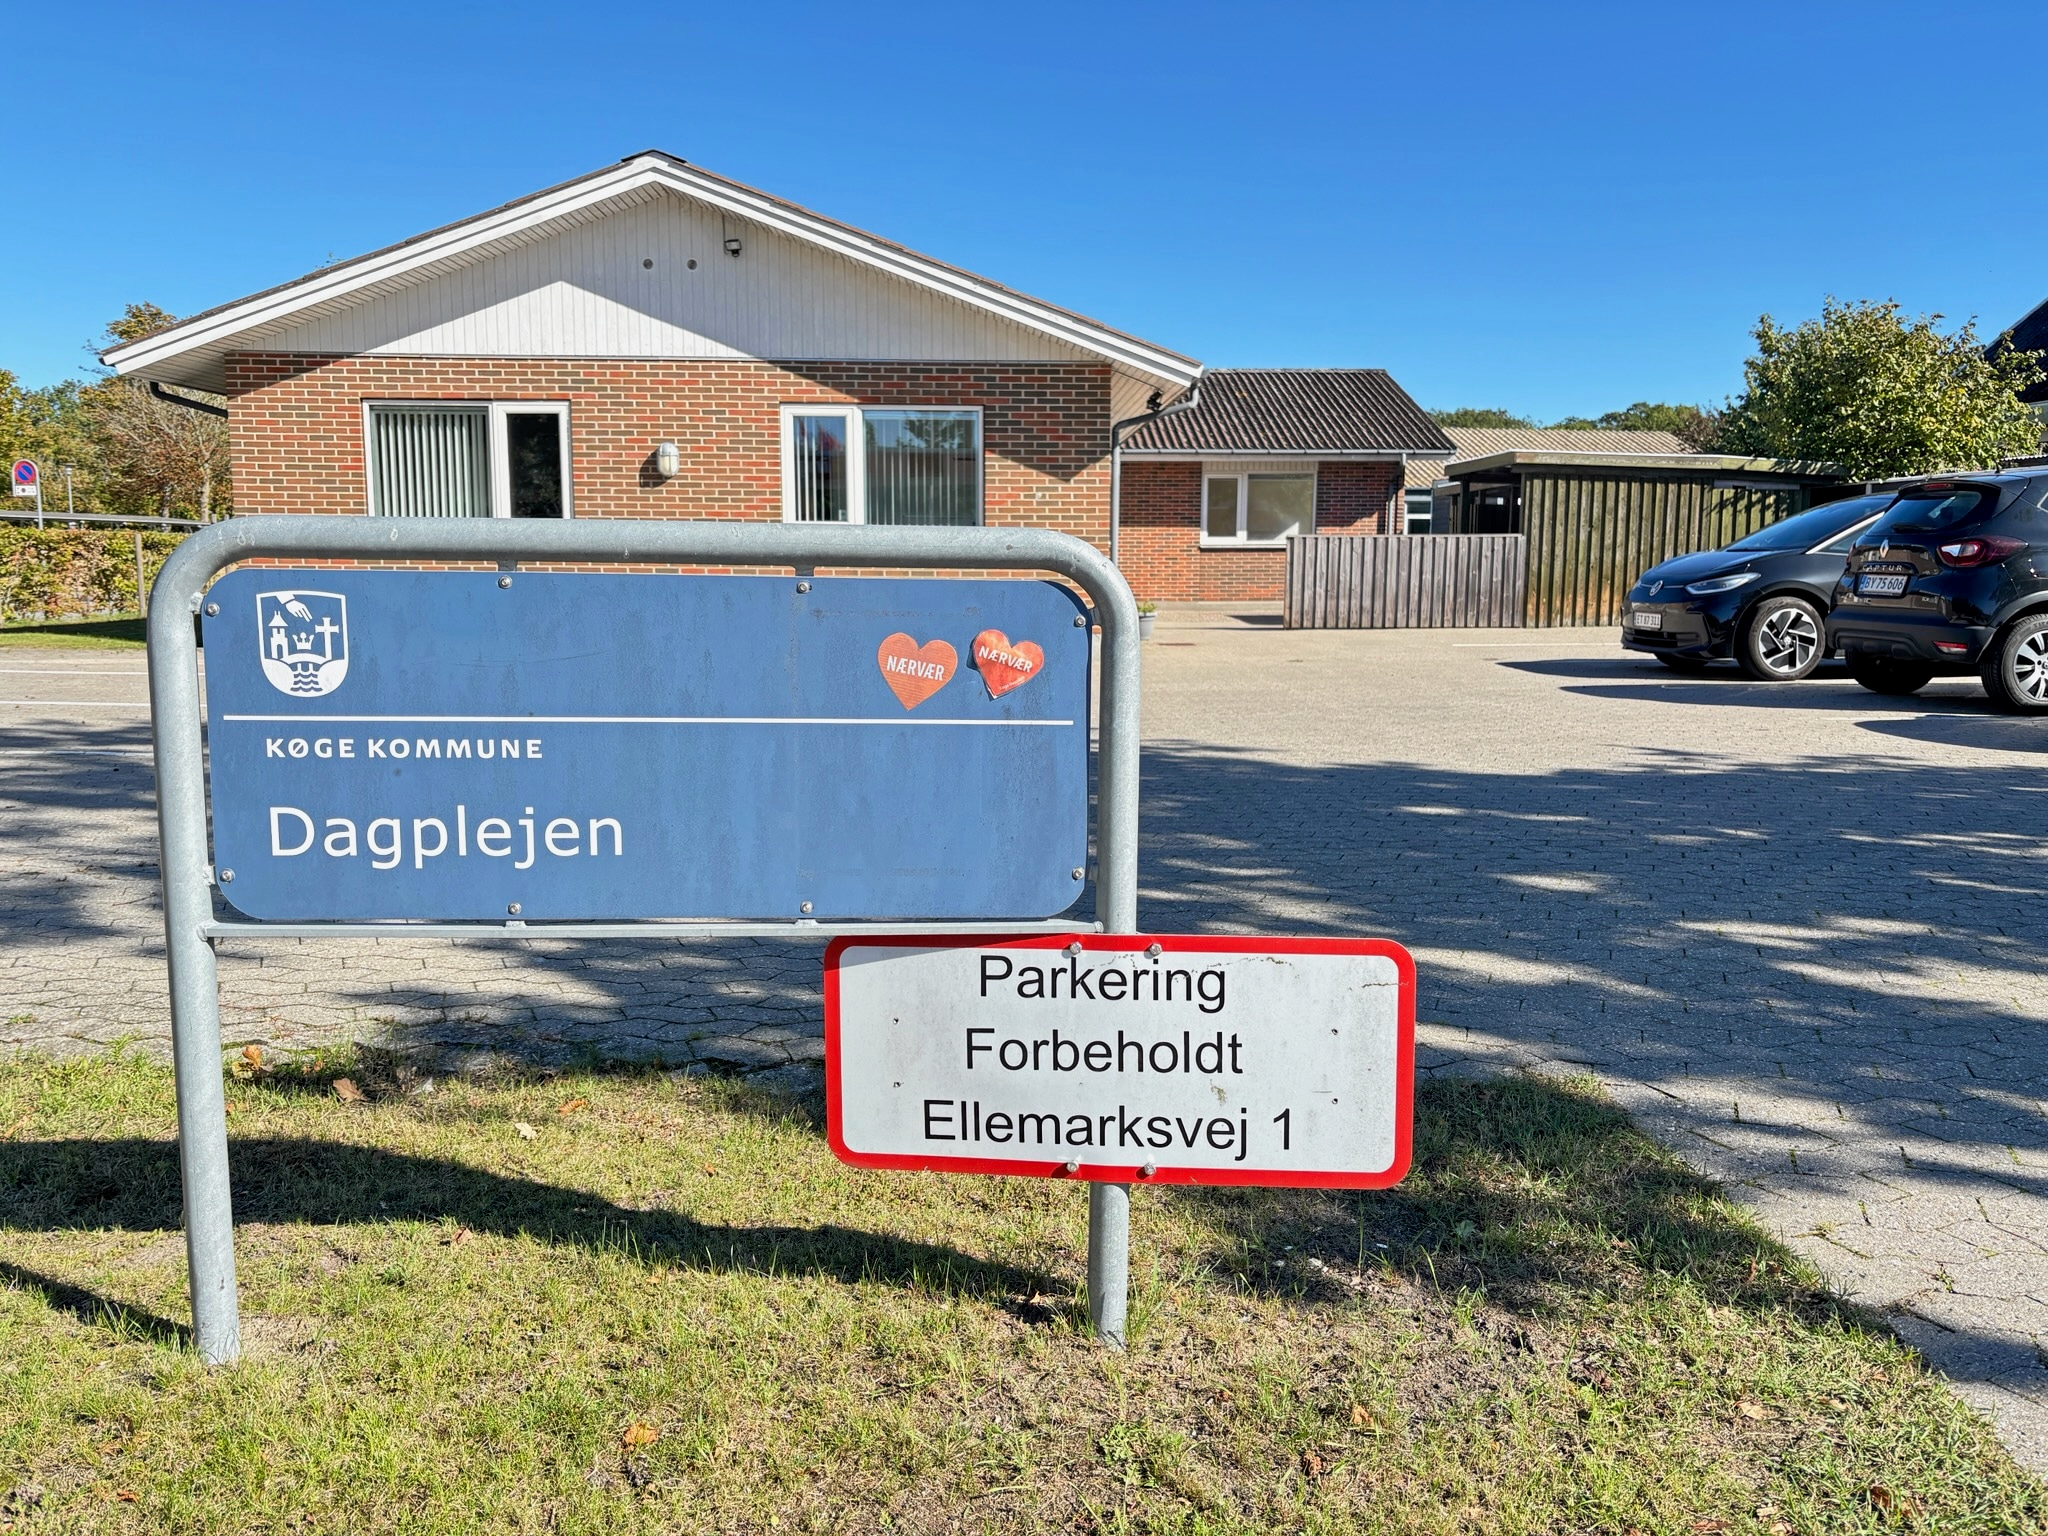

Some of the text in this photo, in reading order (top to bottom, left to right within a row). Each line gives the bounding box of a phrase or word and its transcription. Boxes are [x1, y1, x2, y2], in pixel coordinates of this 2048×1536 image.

[1862, 564, 1902, 572] CAPTUR
[1865, 576, 1904, 590] BY 75 606
[886, 655, 945, 682] NÆRVÆR
[978, 645, 1033, 673] NÆRVÆR
[266, 737, 543, 759] KØGE KOMMUNE
[269, 804, 623, 870] Dagplejen
[980, 954, 1225, 1014] Parkering
[966, 1027, 1243, 1074] Forbeholdt
[923, 1099, 1290, 1162] Ellemarksvej 1
